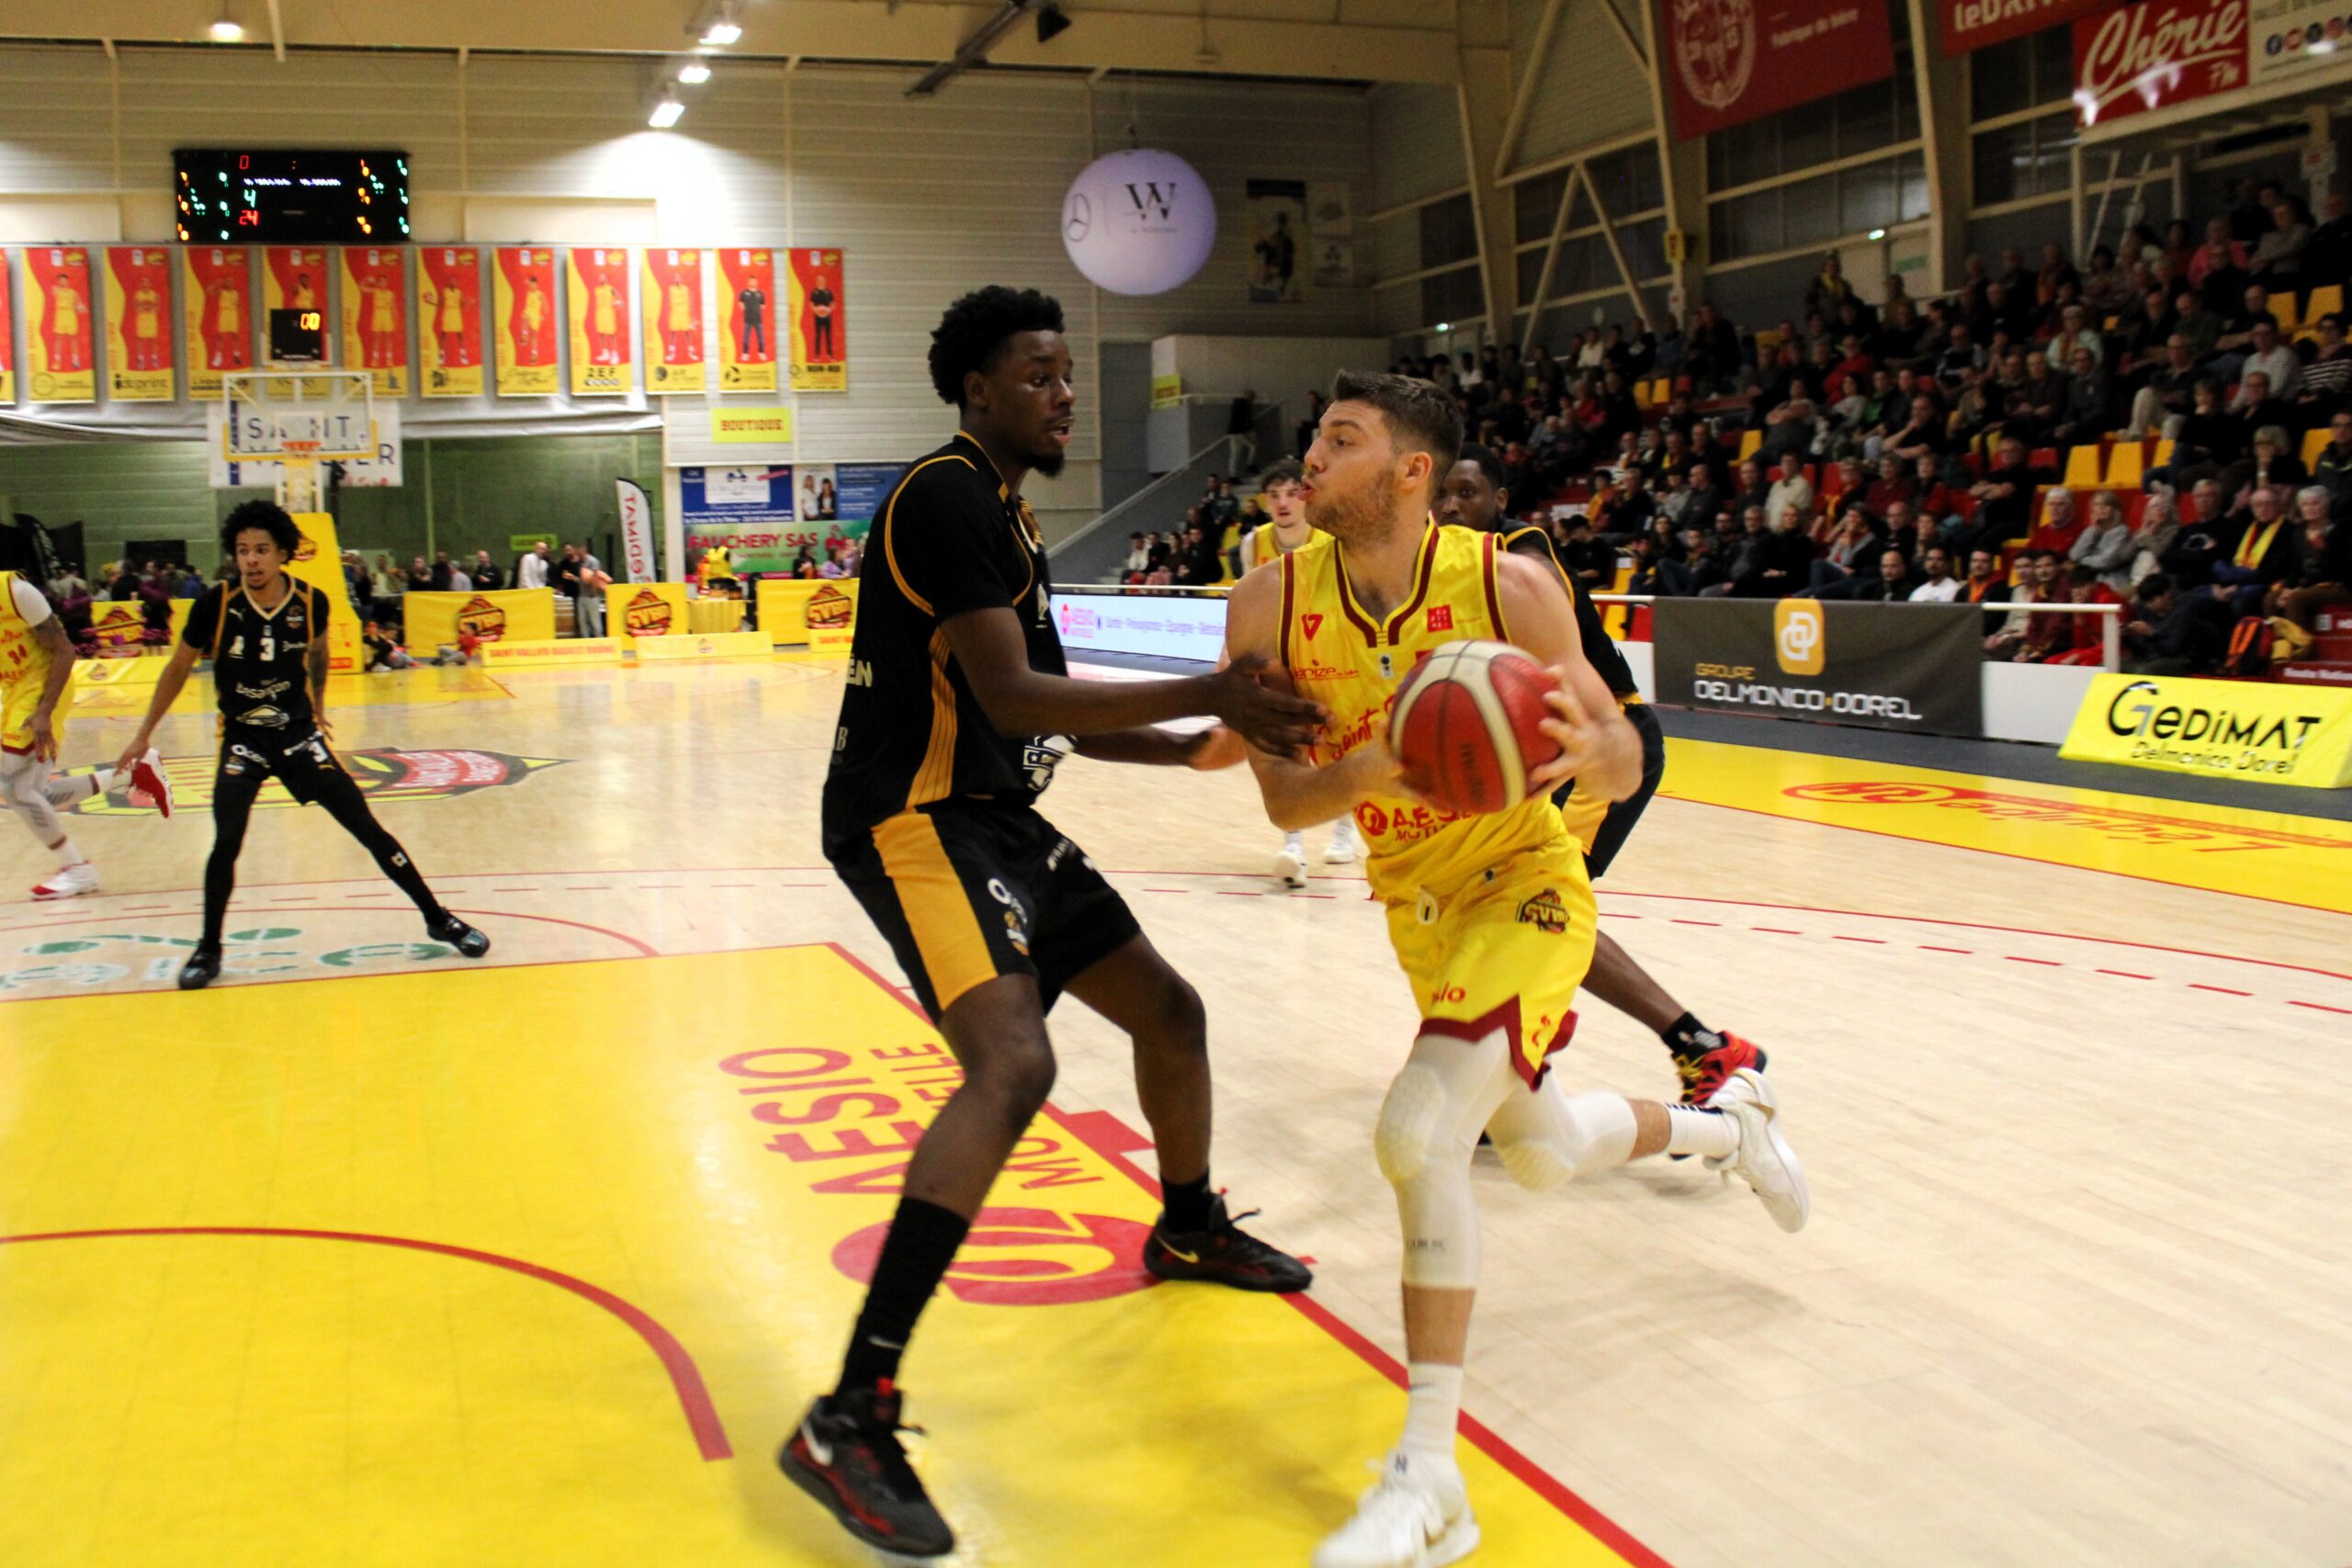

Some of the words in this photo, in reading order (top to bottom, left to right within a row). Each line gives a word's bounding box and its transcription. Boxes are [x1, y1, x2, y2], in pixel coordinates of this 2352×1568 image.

[2080, 0, 2248, 93] Chérie
[243, 189, 256, 208] 4
[239, 209, 259, 226] 24
[720, 419, 783, 431] BOUTIQUE
[786, 532, 819, 547] SAS
[259, 637, 275, 661] 3
[1695, 663, 1756, 681] GROUPE
[311, 740, 329, 762] 3
[2131, 741, 2231, 770] Delmonico
[2237, 750, 2296, 774] Dorel
